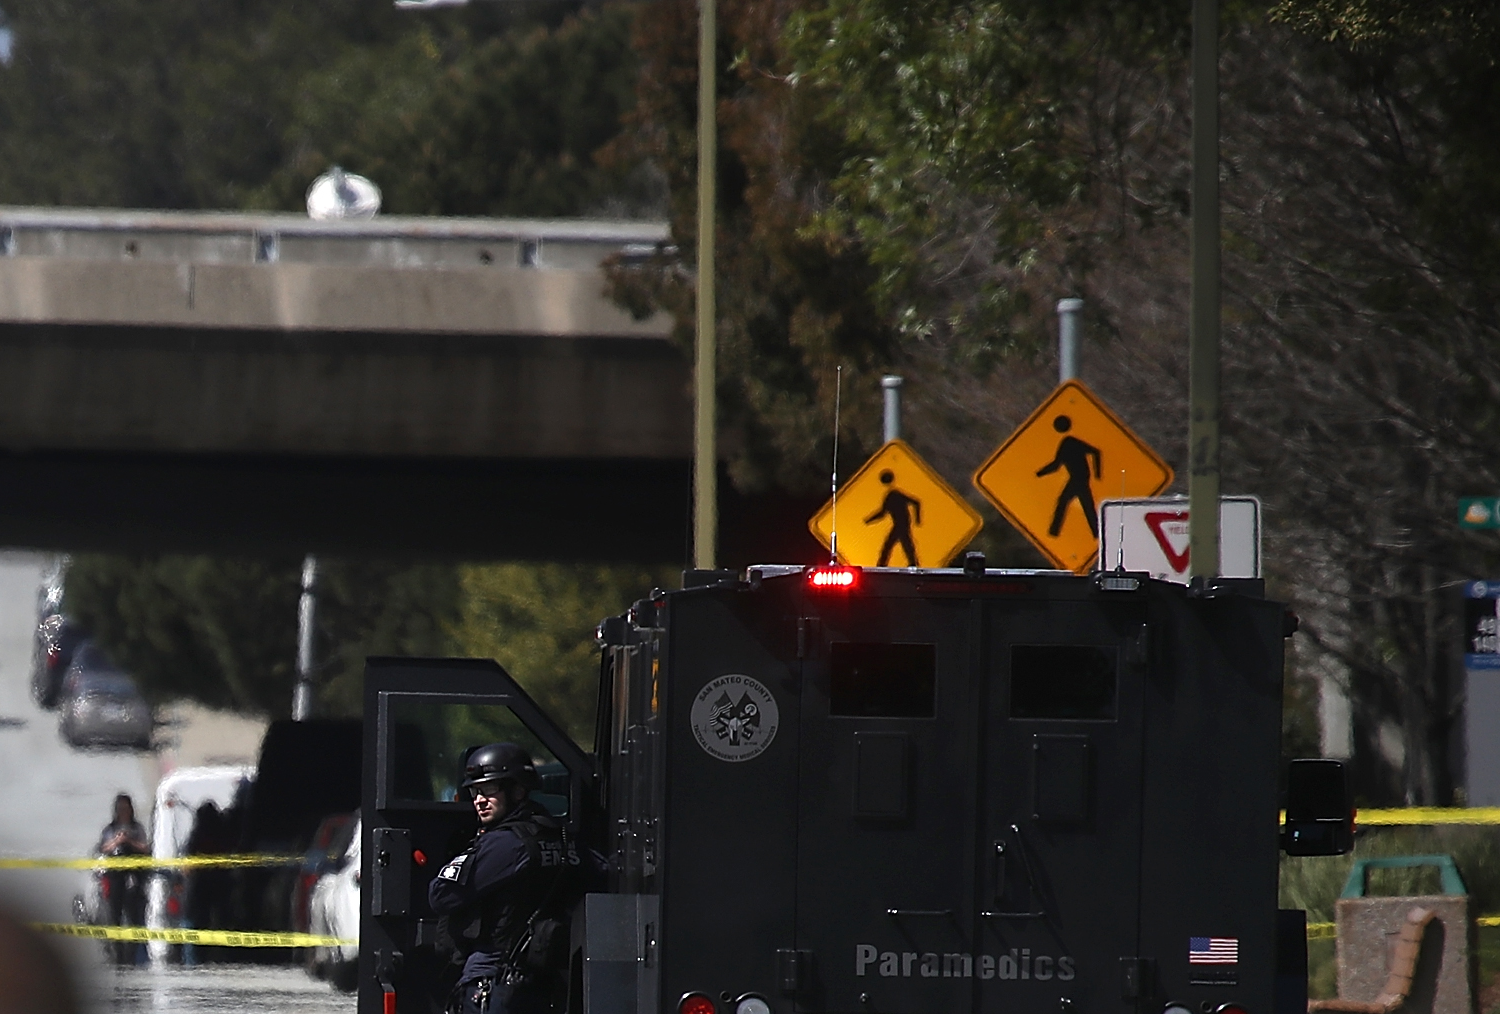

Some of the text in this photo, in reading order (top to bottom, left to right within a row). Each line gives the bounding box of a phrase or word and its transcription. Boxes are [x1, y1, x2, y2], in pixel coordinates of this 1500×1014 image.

[699, 677, 772, 702] SAN MATEO COUNTY
[855, 943, 1077, 981] Paramedics
